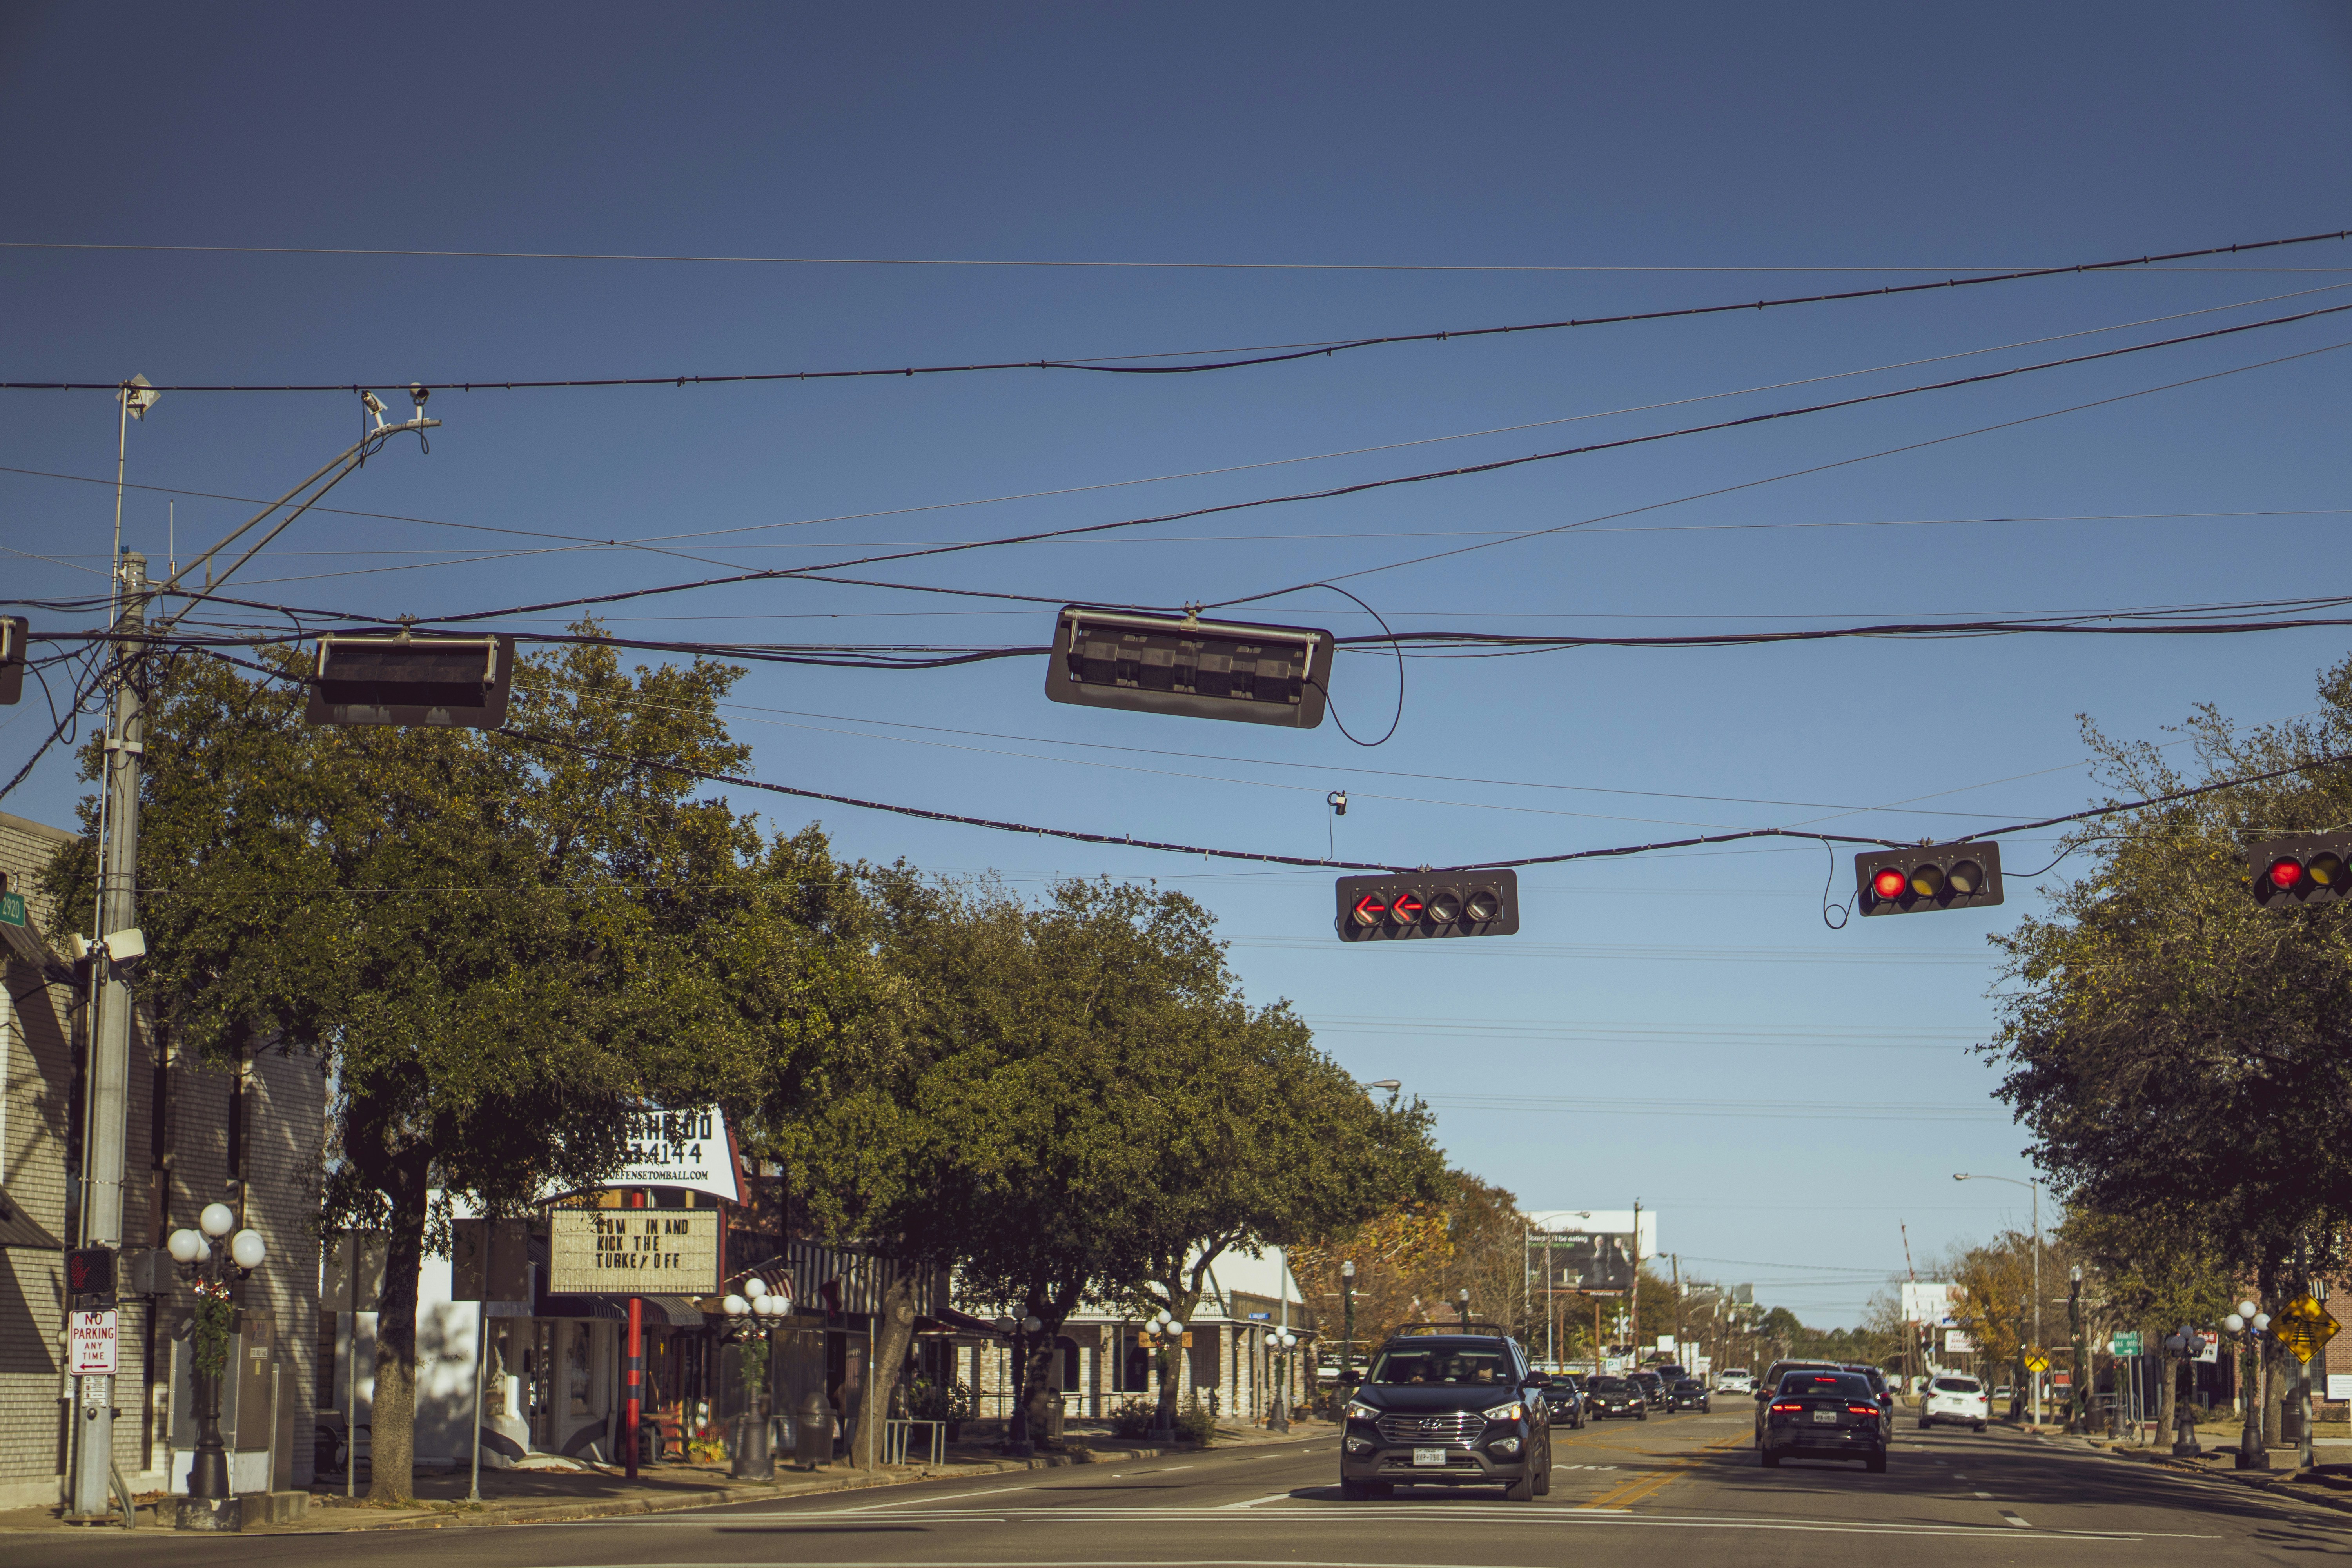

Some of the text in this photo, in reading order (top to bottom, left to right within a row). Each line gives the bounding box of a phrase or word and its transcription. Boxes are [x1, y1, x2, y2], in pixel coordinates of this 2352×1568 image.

[3, 897, 20, 918] 2920
[609, 1171, 708, 1180] DEFENSETOMBALL.COM
[646, 1219, 658, 1234] IN
[665, 1219, 688, 1234] AND
[597, 1236, 659, 1251] KICK THE
[653, 1253, 680, 1269] OFF
[85, 1313, 102, 1325] NO
[73, 1327, 114, 1339] PARKING
